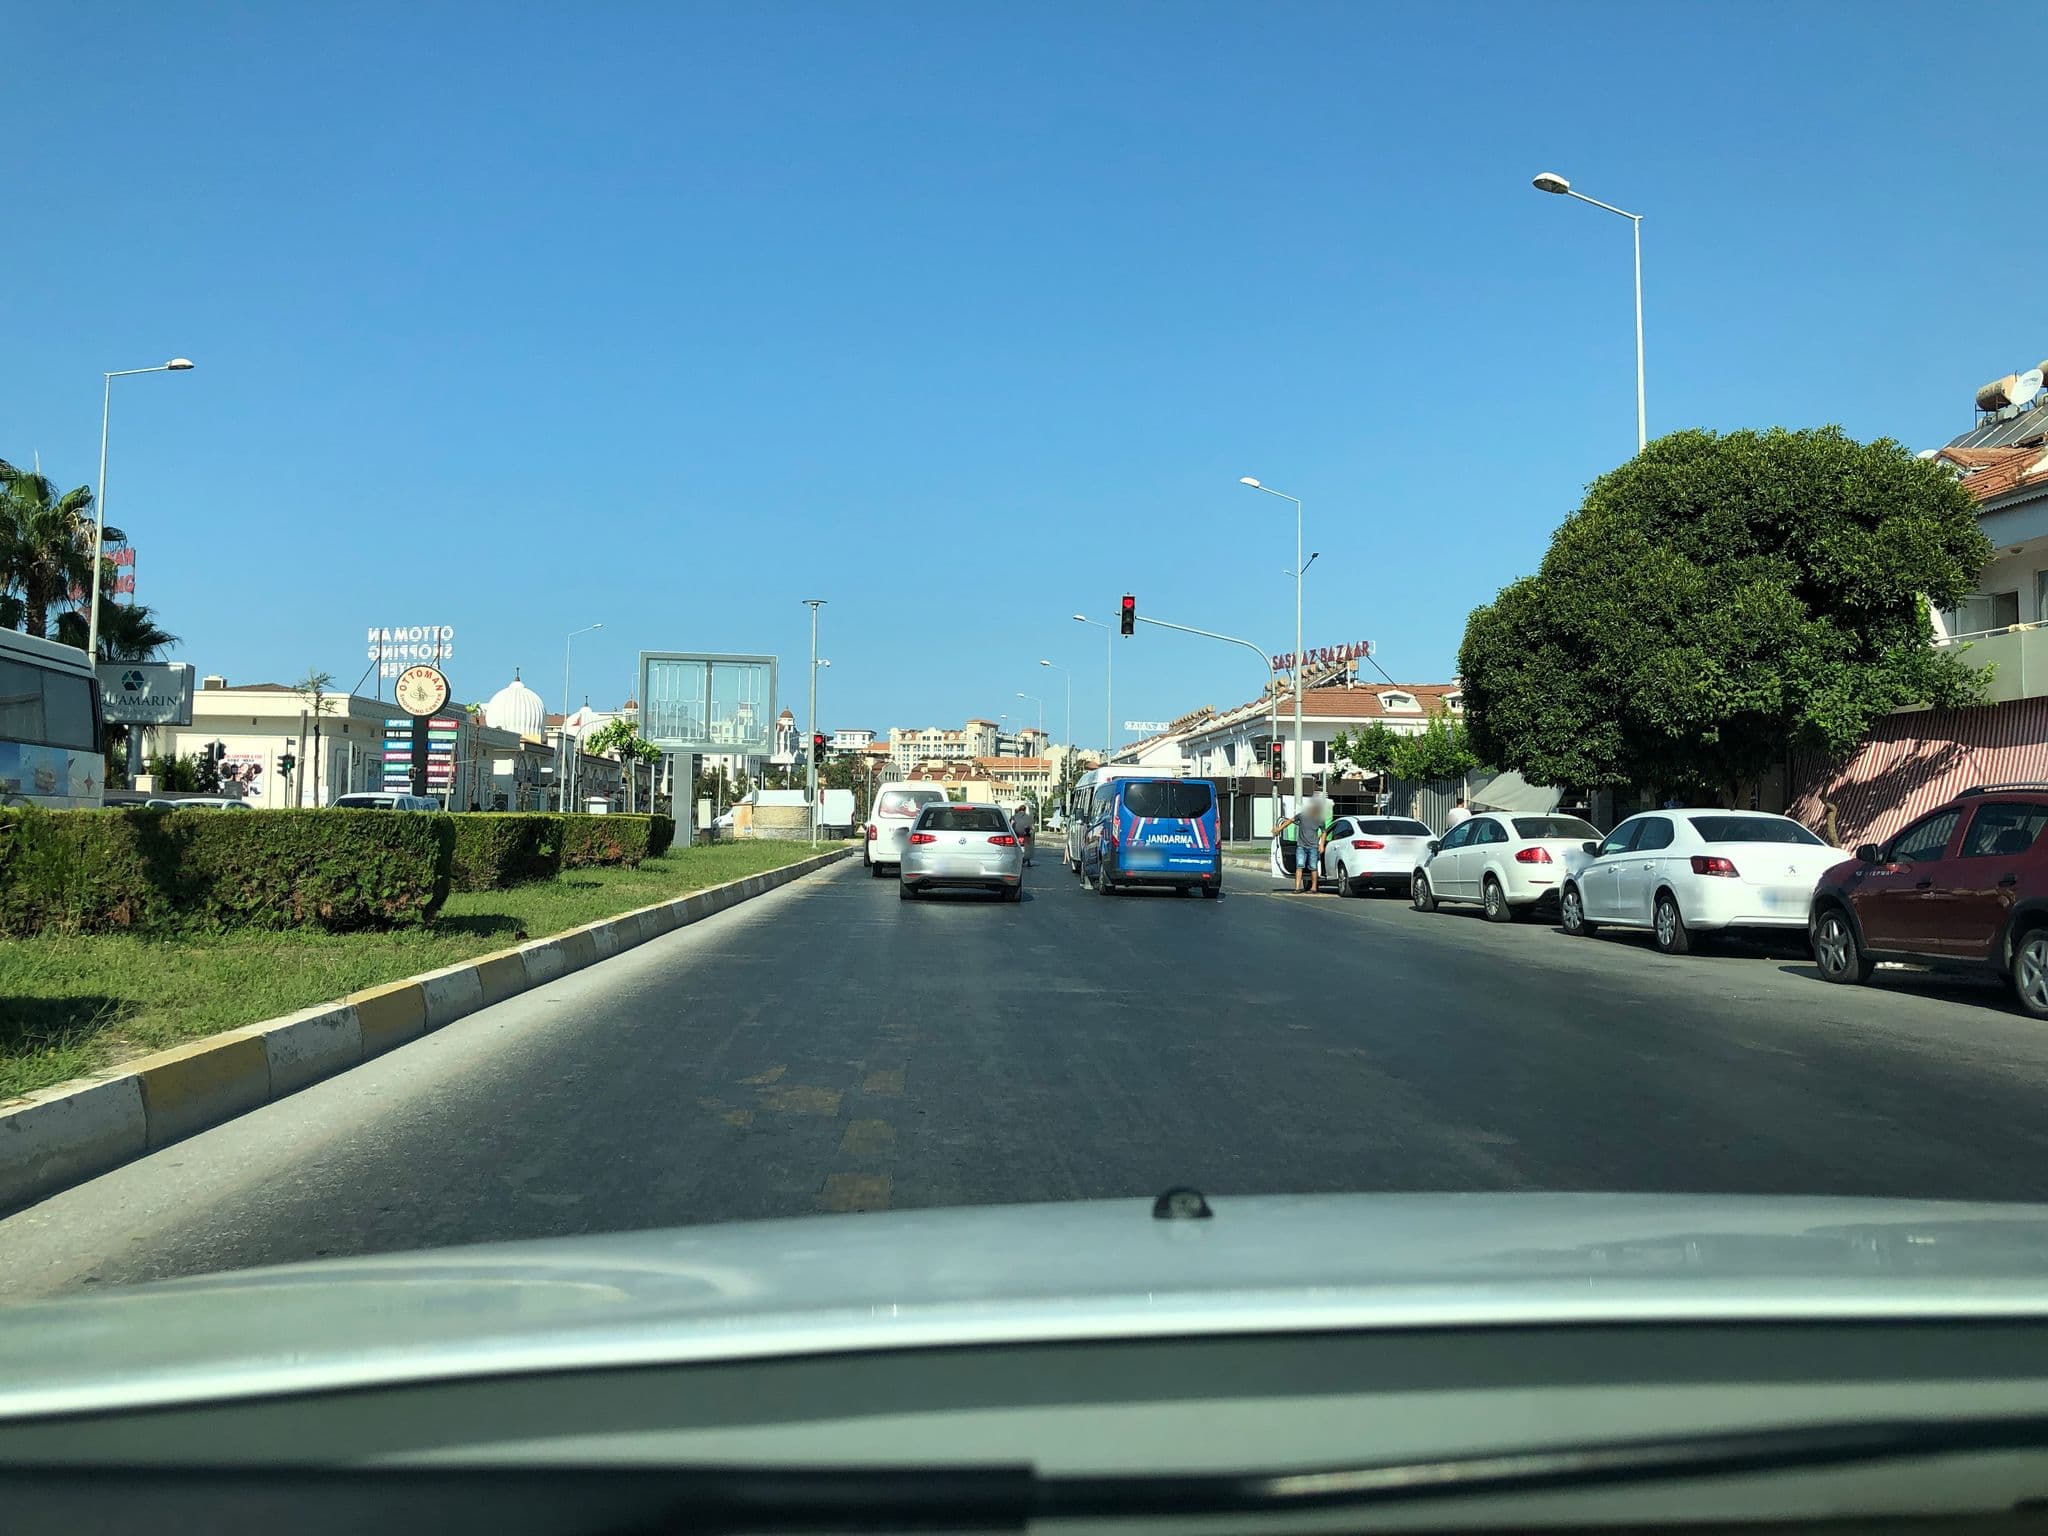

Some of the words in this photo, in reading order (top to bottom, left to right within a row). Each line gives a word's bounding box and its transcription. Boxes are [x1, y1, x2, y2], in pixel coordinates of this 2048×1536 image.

[1320, 641, 1369, 663] BAZAAR
[399, 670, 444, 692] OTTOMAN
[100, 695, 177, 708] QUAMARIN
[400, 694, 424, 713] SHOPPING
[1147, 835, 1193, 845] JANDARMA
